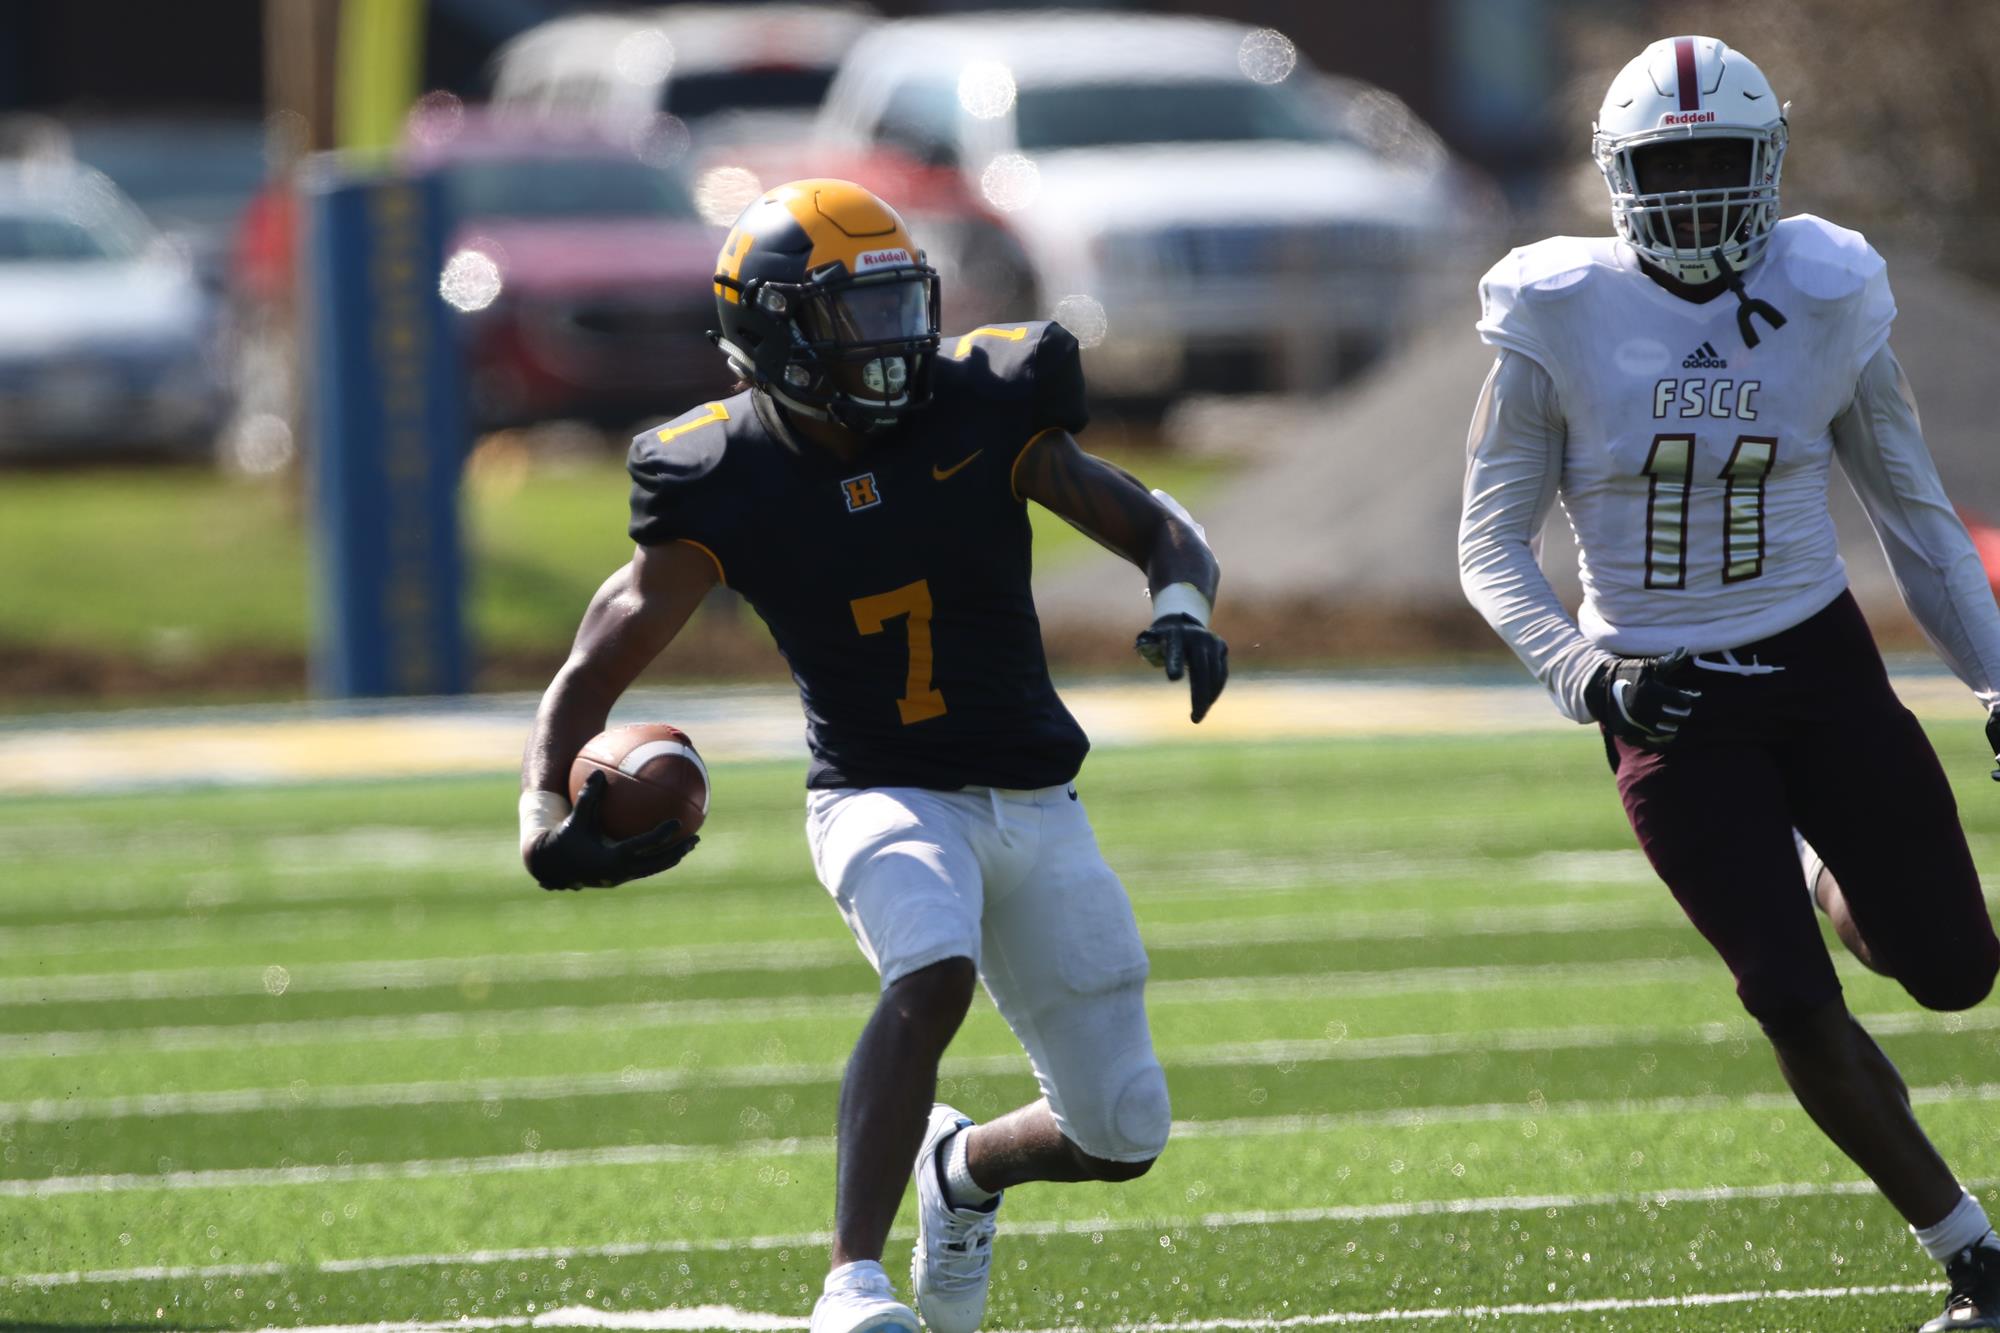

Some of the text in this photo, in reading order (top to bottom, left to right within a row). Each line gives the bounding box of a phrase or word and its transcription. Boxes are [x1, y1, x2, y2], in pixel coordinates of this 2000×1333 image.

[1665, 112, 1715, 124] Riddell
[864, 250, 908, 265] Riddell
[1682, 358, 1728, 369] adidas
[1653, 378, 1761, 421] FSCC
[657, 402, 730, 443] 7
[841, 472, 882, 512] H
[1640, 433, 1778, 590] 11
[850, 579, 947, 725] 7
